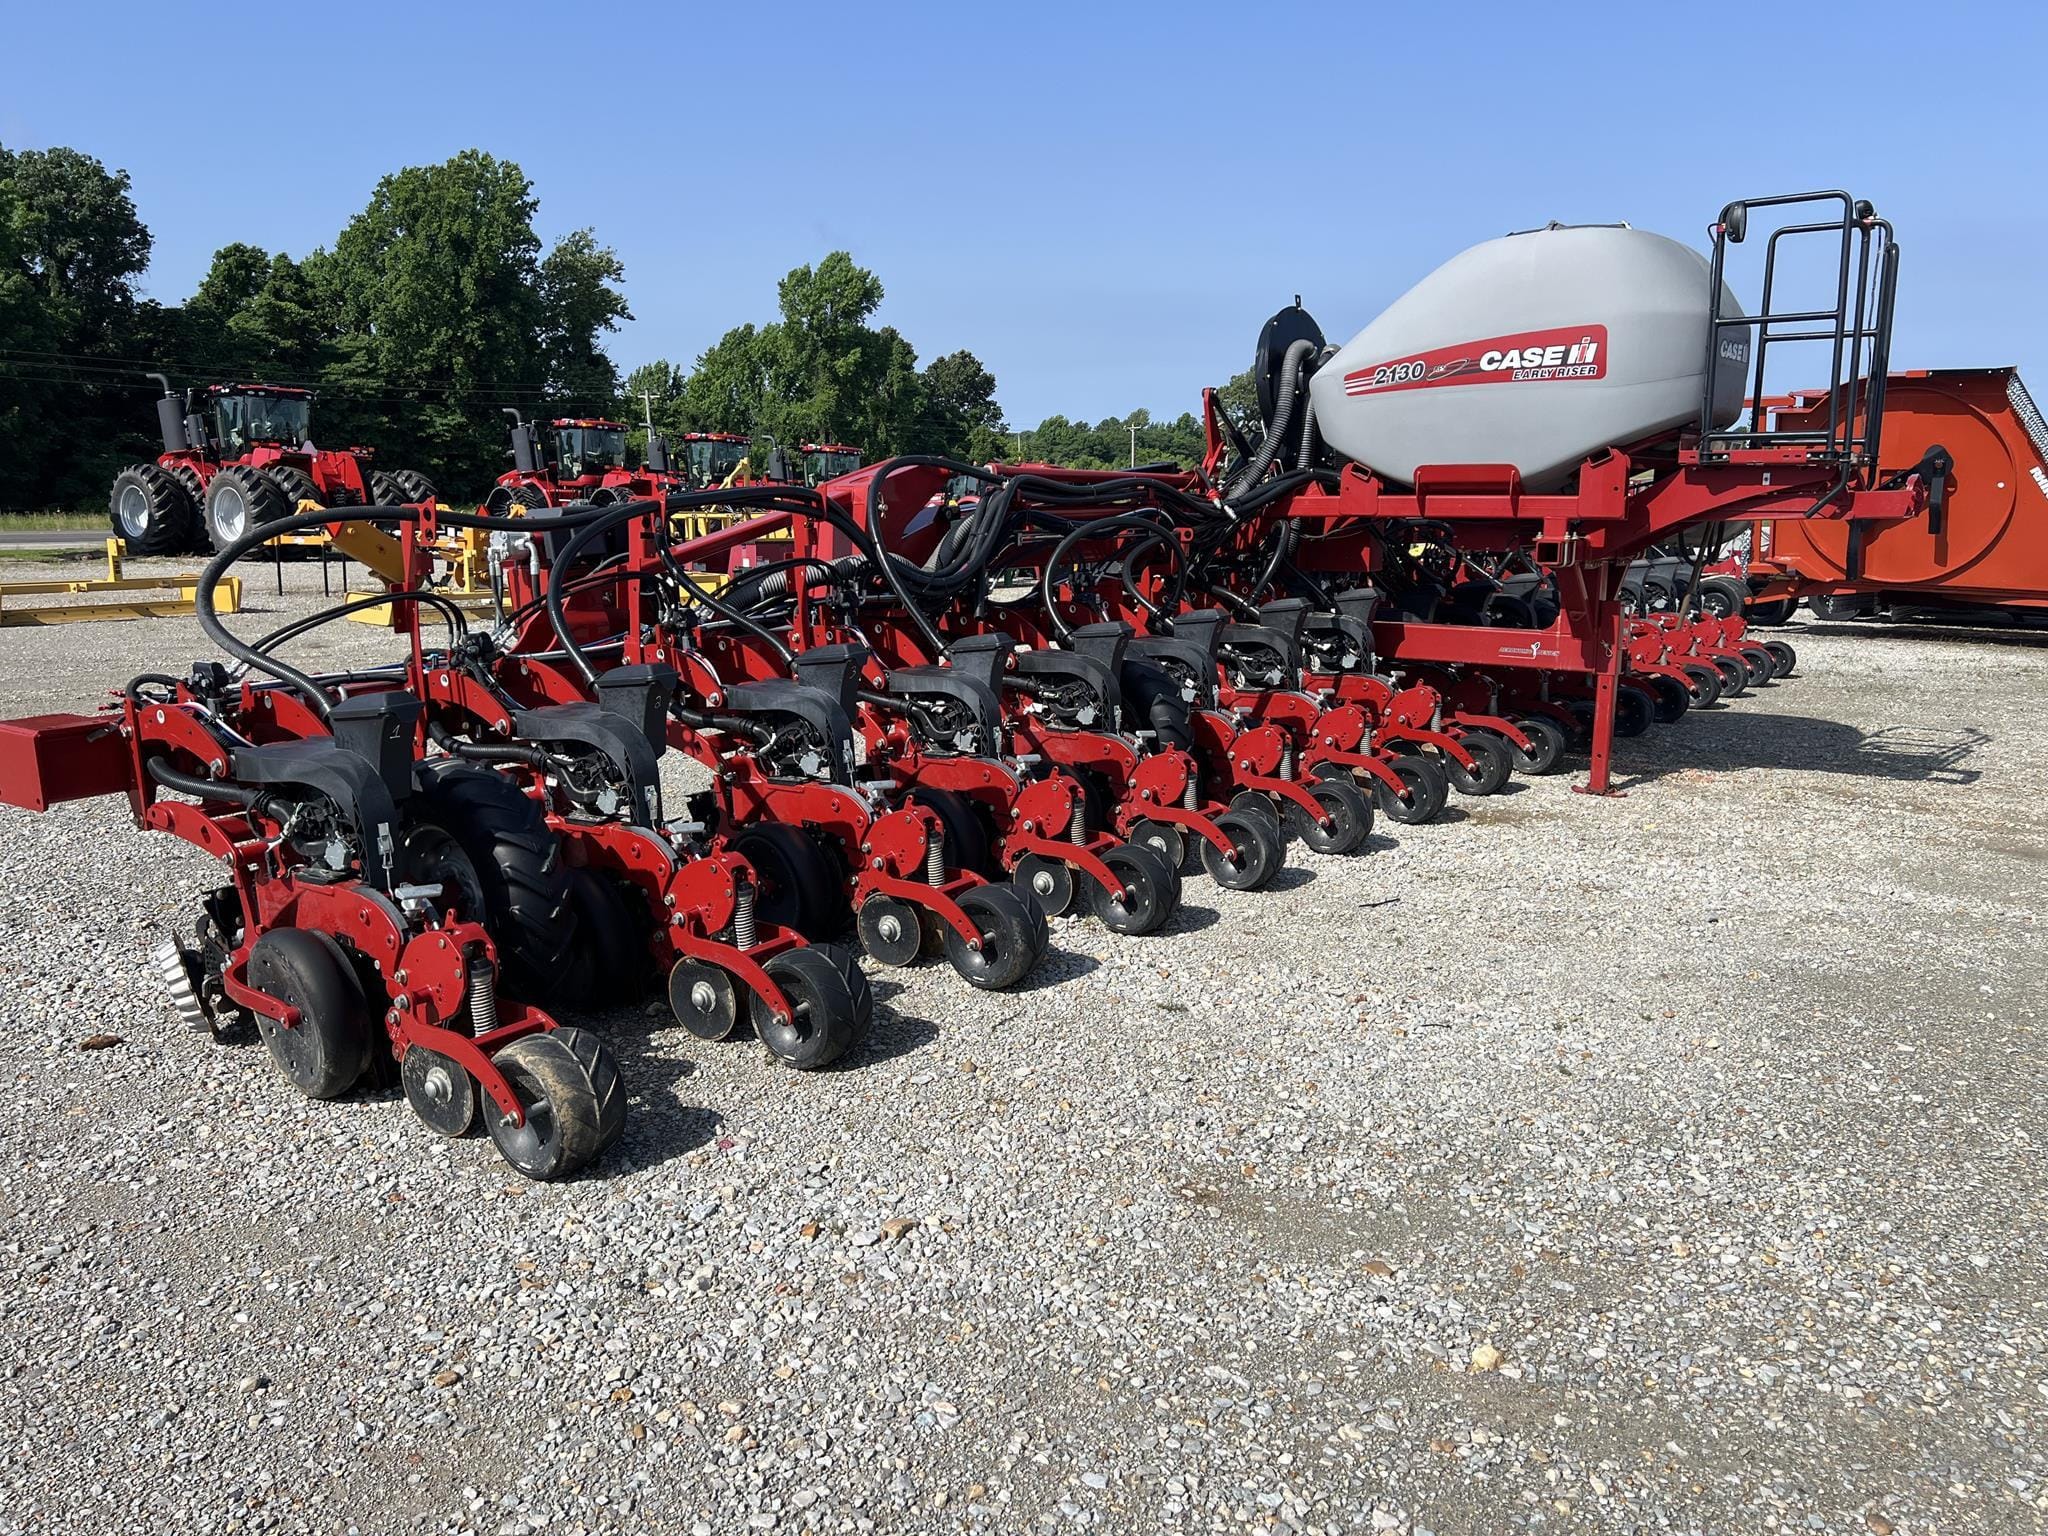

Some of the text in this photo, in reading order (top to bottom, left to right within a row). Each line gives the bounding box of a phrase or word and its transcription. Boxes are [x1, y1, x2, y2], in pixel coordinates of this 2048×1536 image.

[1479, 345, 1565, 371] CASE
[1720, 340, 1743, 361] CASE
[1373, 361, 1425, 386] 2130
[1512, 365, 1598, 381] EARLY RISER
[390, 724, 400, 739] 1
